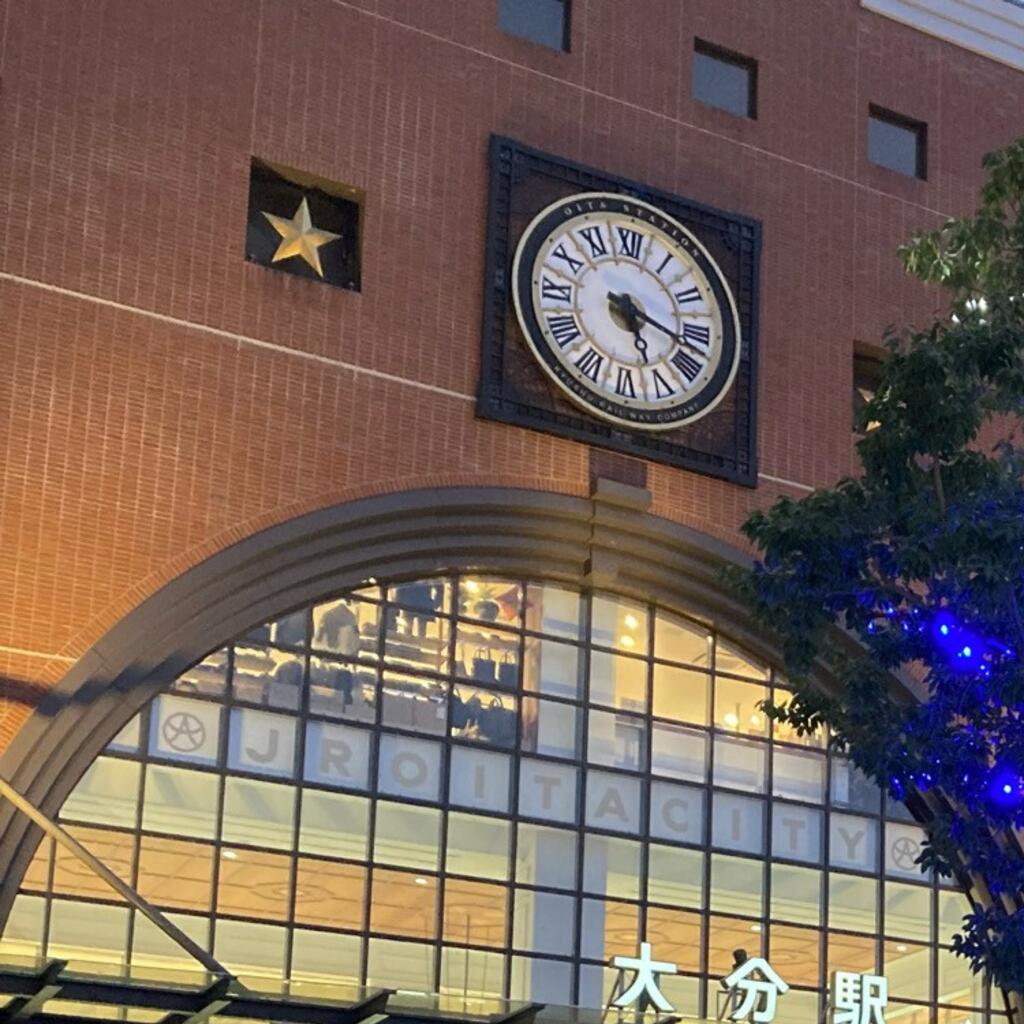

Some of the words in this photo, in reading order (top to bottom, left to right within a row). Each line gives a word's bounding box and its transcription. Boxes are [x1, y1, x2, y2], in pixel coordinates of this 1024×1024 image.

[551, 242, 584, 275] X
[577, 225, 609, 259] XI
[616, 226, 645, 260] XII
[542, 276, 572, 304] IX
[675, 286, 702, 304] II
[546, 315, 582, 350] VIII
[573, 347, 604, 384] VII
[614, 366, 638, 399] VI
[652, 368, 677, 399] V
